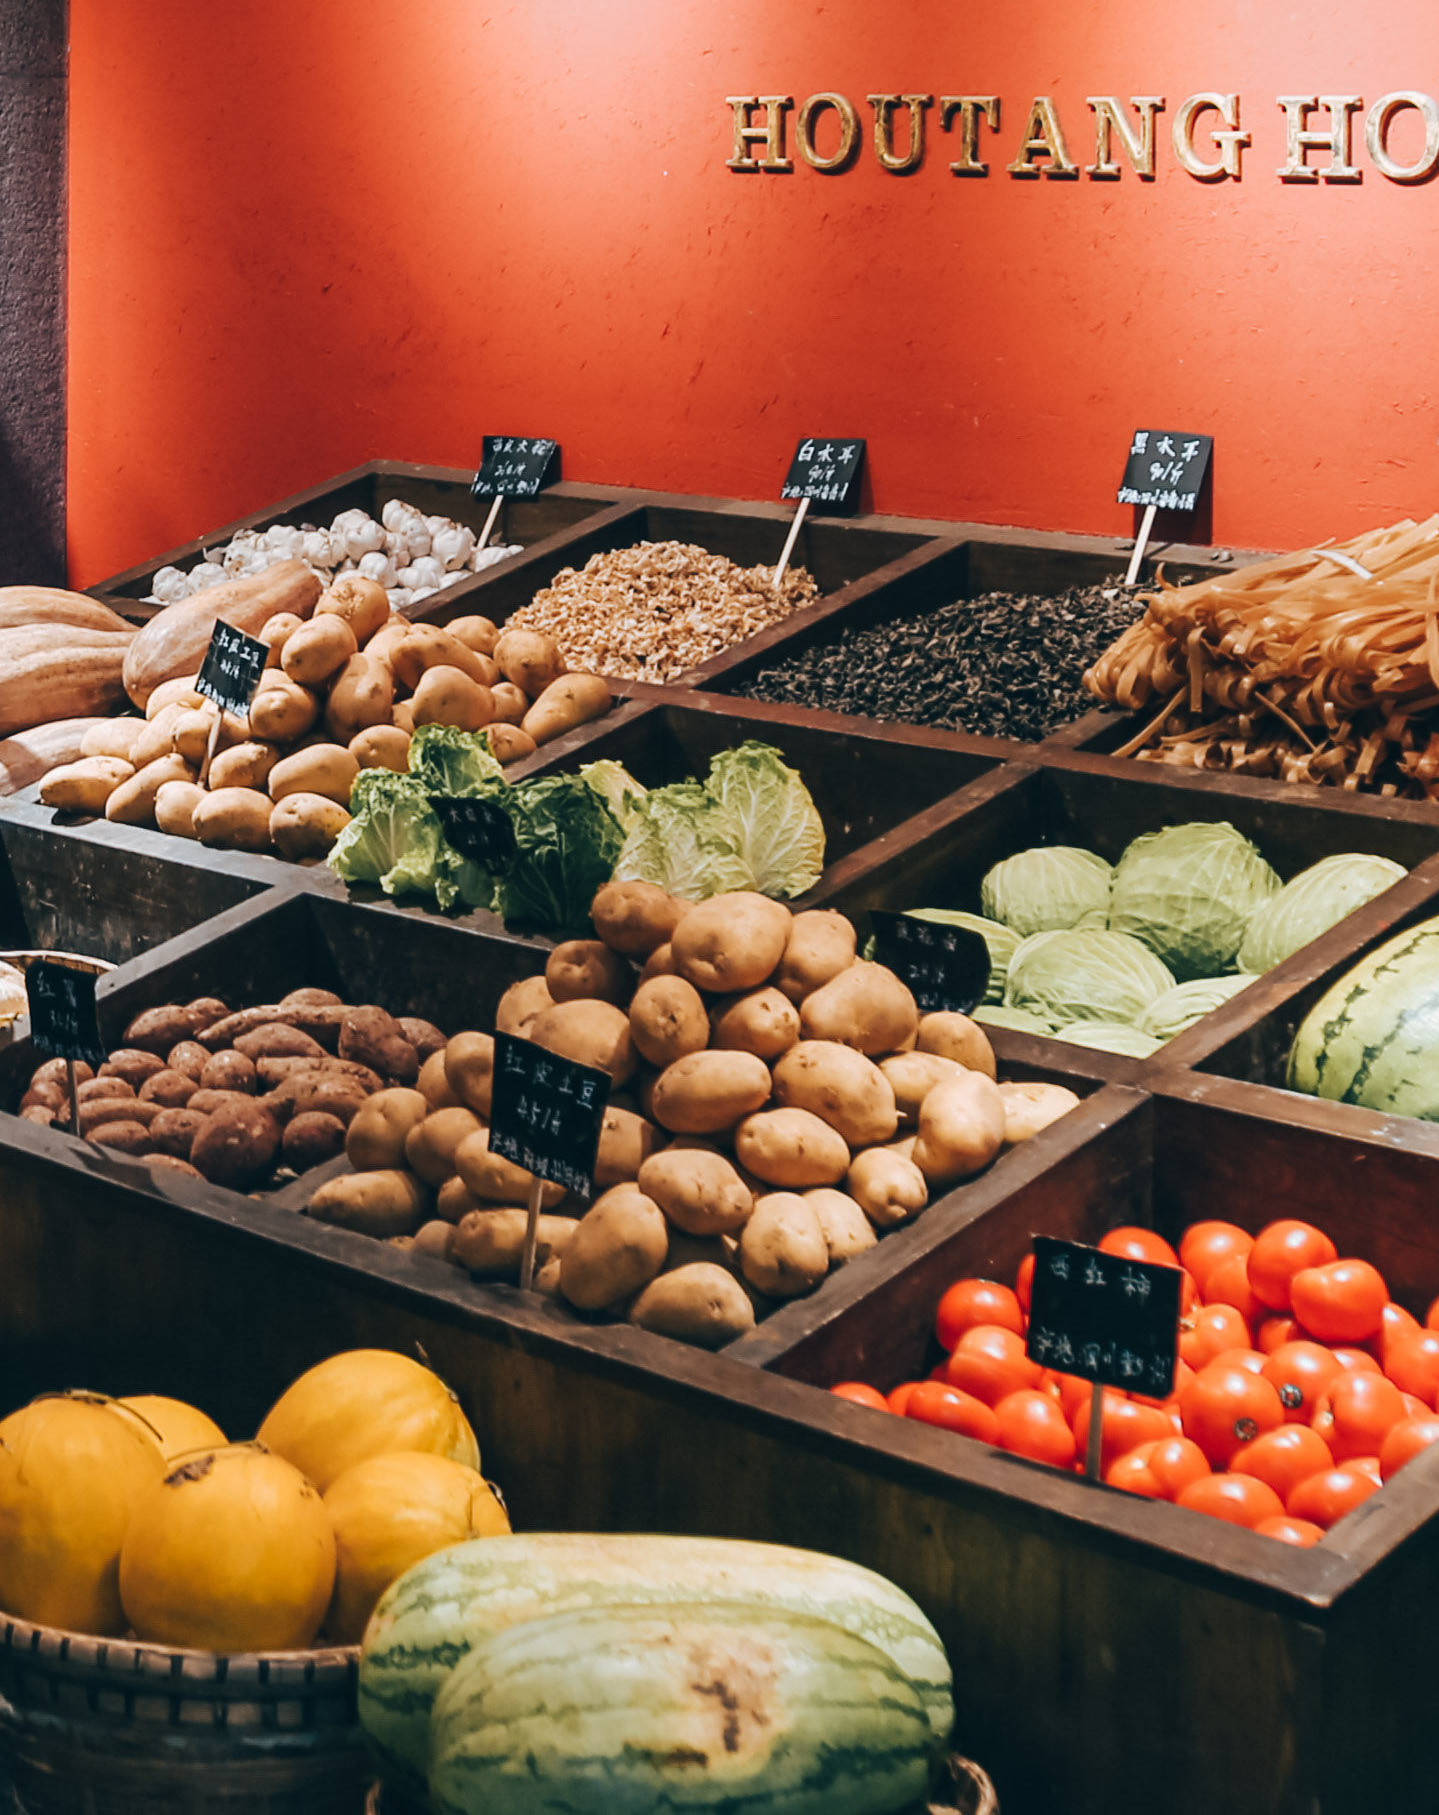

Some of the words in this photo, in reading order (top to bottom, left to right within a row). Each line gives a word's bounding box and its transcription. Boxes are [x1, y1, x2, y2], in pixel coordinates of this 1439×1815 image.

[725, 90, 1252, 183] HOUTANG
[797, 438, 856, 465] 白木耳
[1130, 431, 1201, 463] 黑木耳
[504, 1043, 598, 1112] 红皮土豆
[1049, 1253, 1153, 1307] 西红柿
